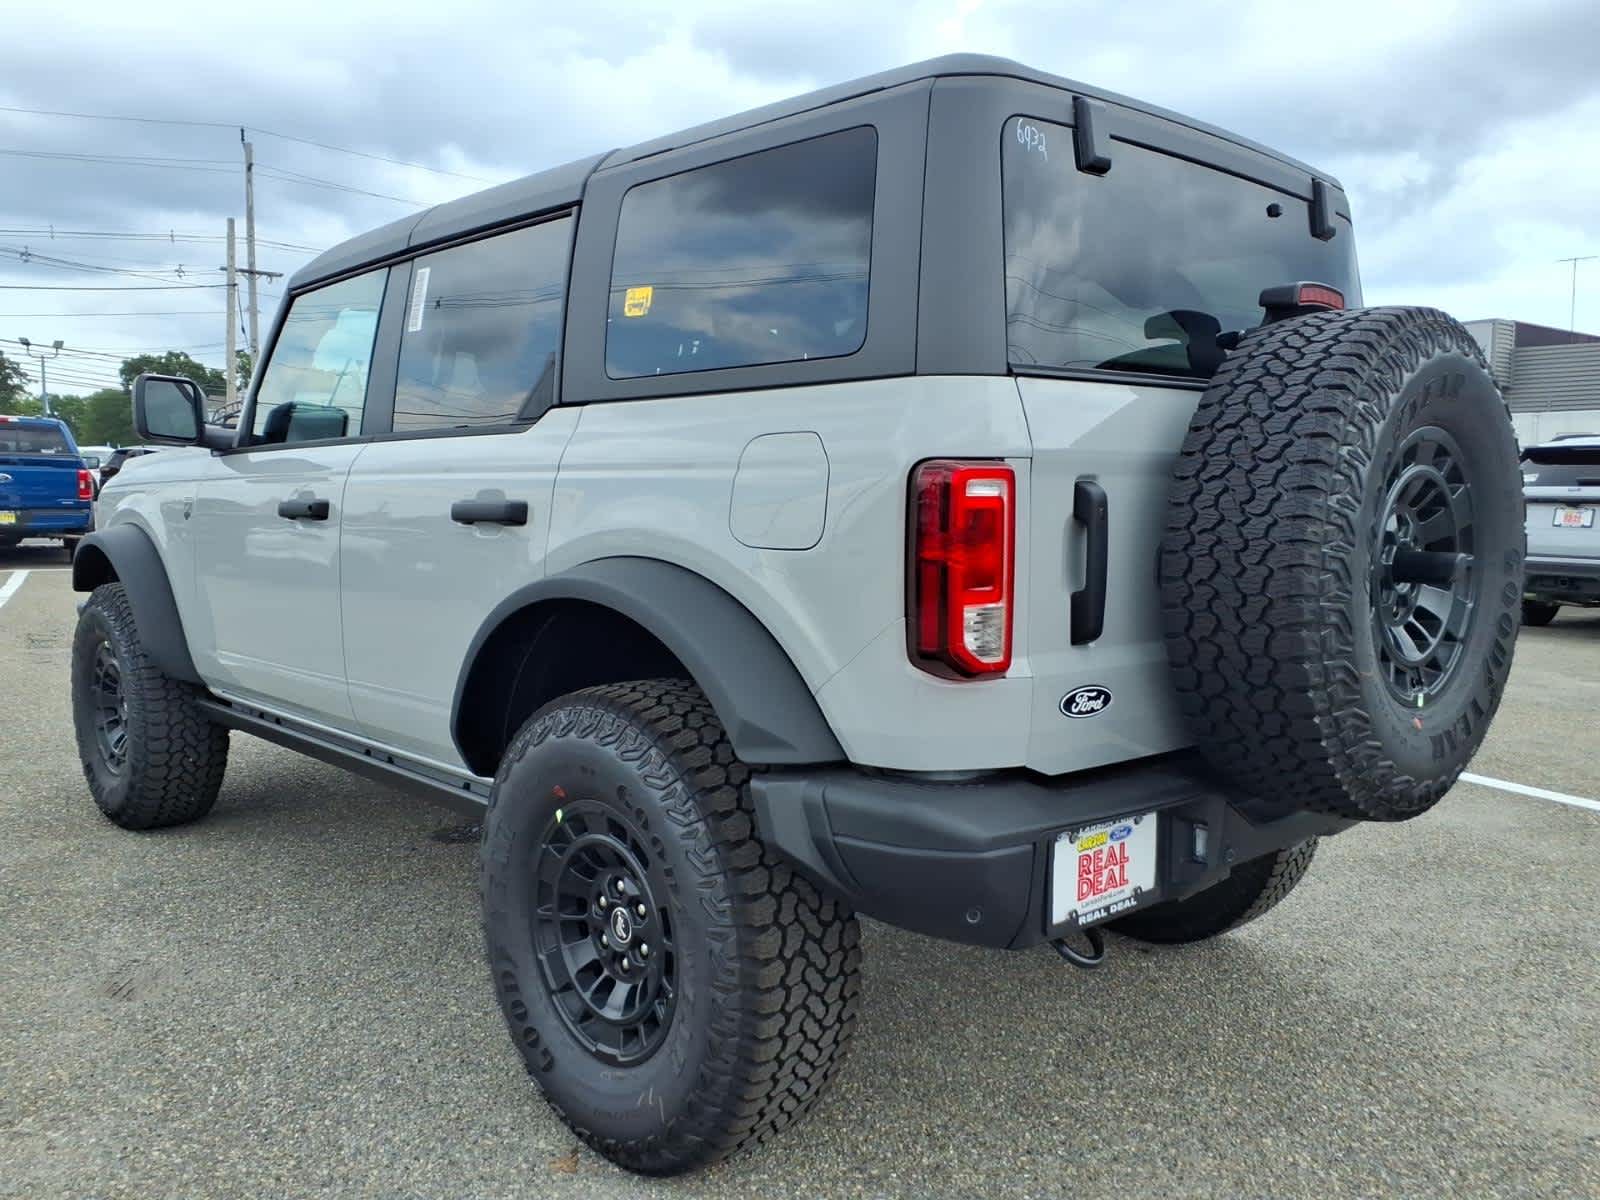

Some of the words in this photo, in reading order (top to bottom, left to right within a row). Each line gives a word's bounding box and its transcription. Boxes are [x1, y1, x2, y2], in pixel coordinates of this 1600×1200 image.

[1071, 691, 1105, 713] Ford
[1078, 842, 1129, 878] REAL
[1077, 864, 1128, 901] DEAL
[1078, 906, 1107, 925] REAL
[1109, 897, 1137, 914] DEAL
